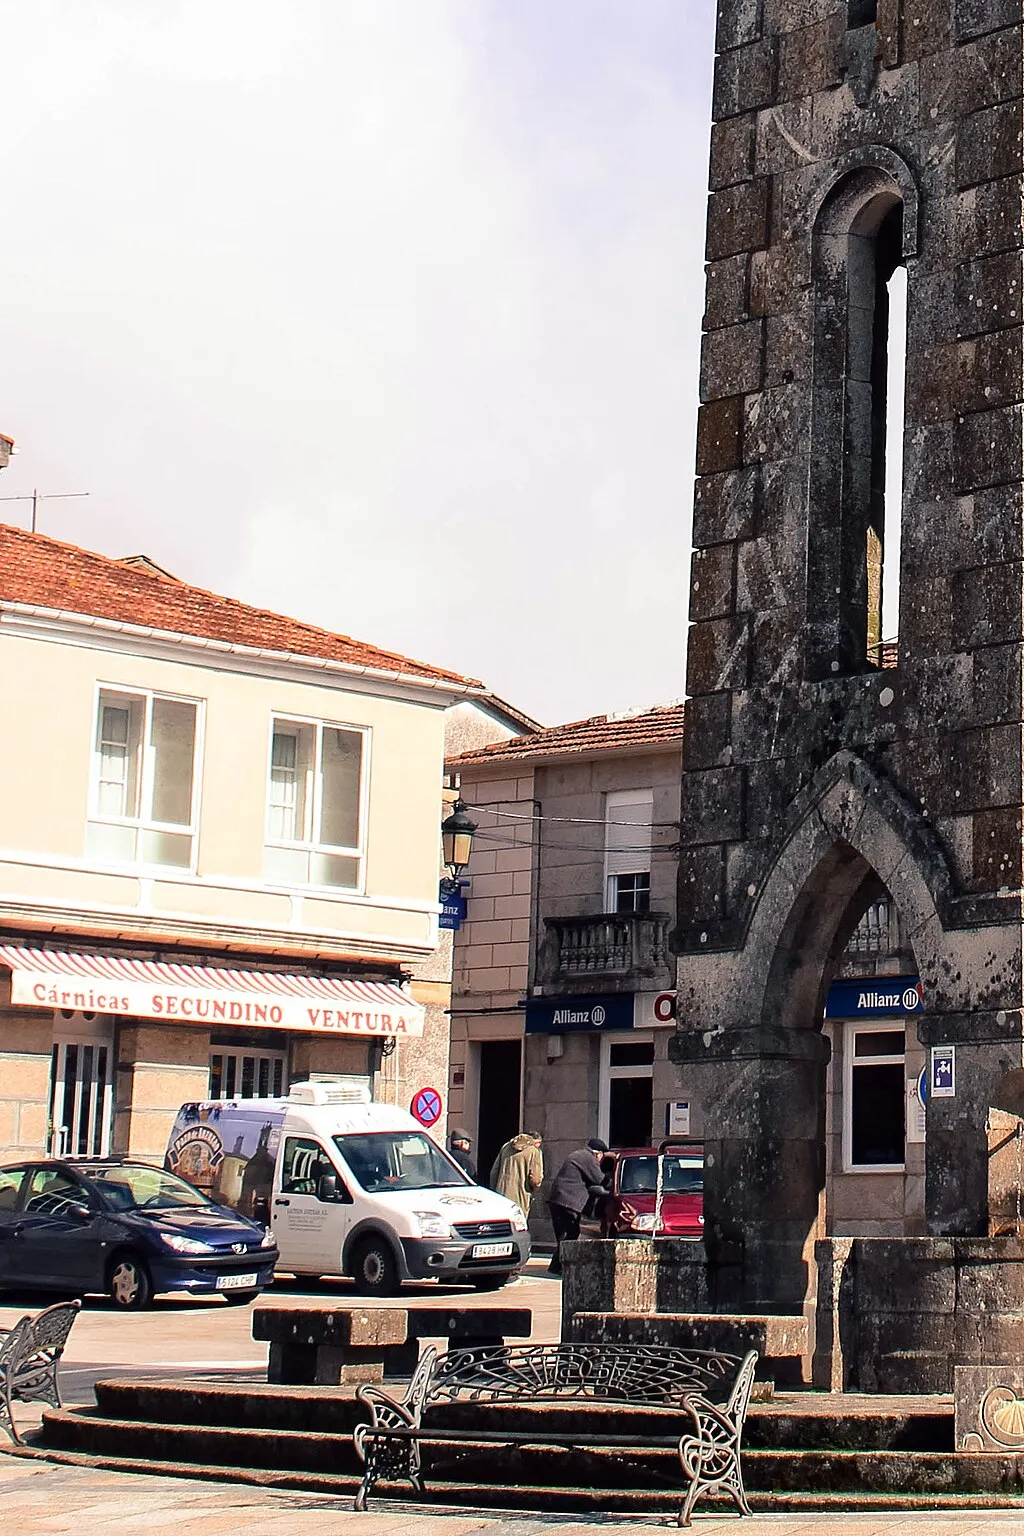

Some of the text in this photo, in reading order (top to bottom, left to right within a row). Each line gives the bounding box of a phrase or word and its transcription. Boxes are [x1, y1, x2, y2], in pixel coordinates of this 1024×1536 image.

[33, 983, 407, 1033] Cárnicas SECUNDINO VENTURA
[857, 992, 900, 1008] Allianz
[553, 1010, 589, 1024] Allianz
